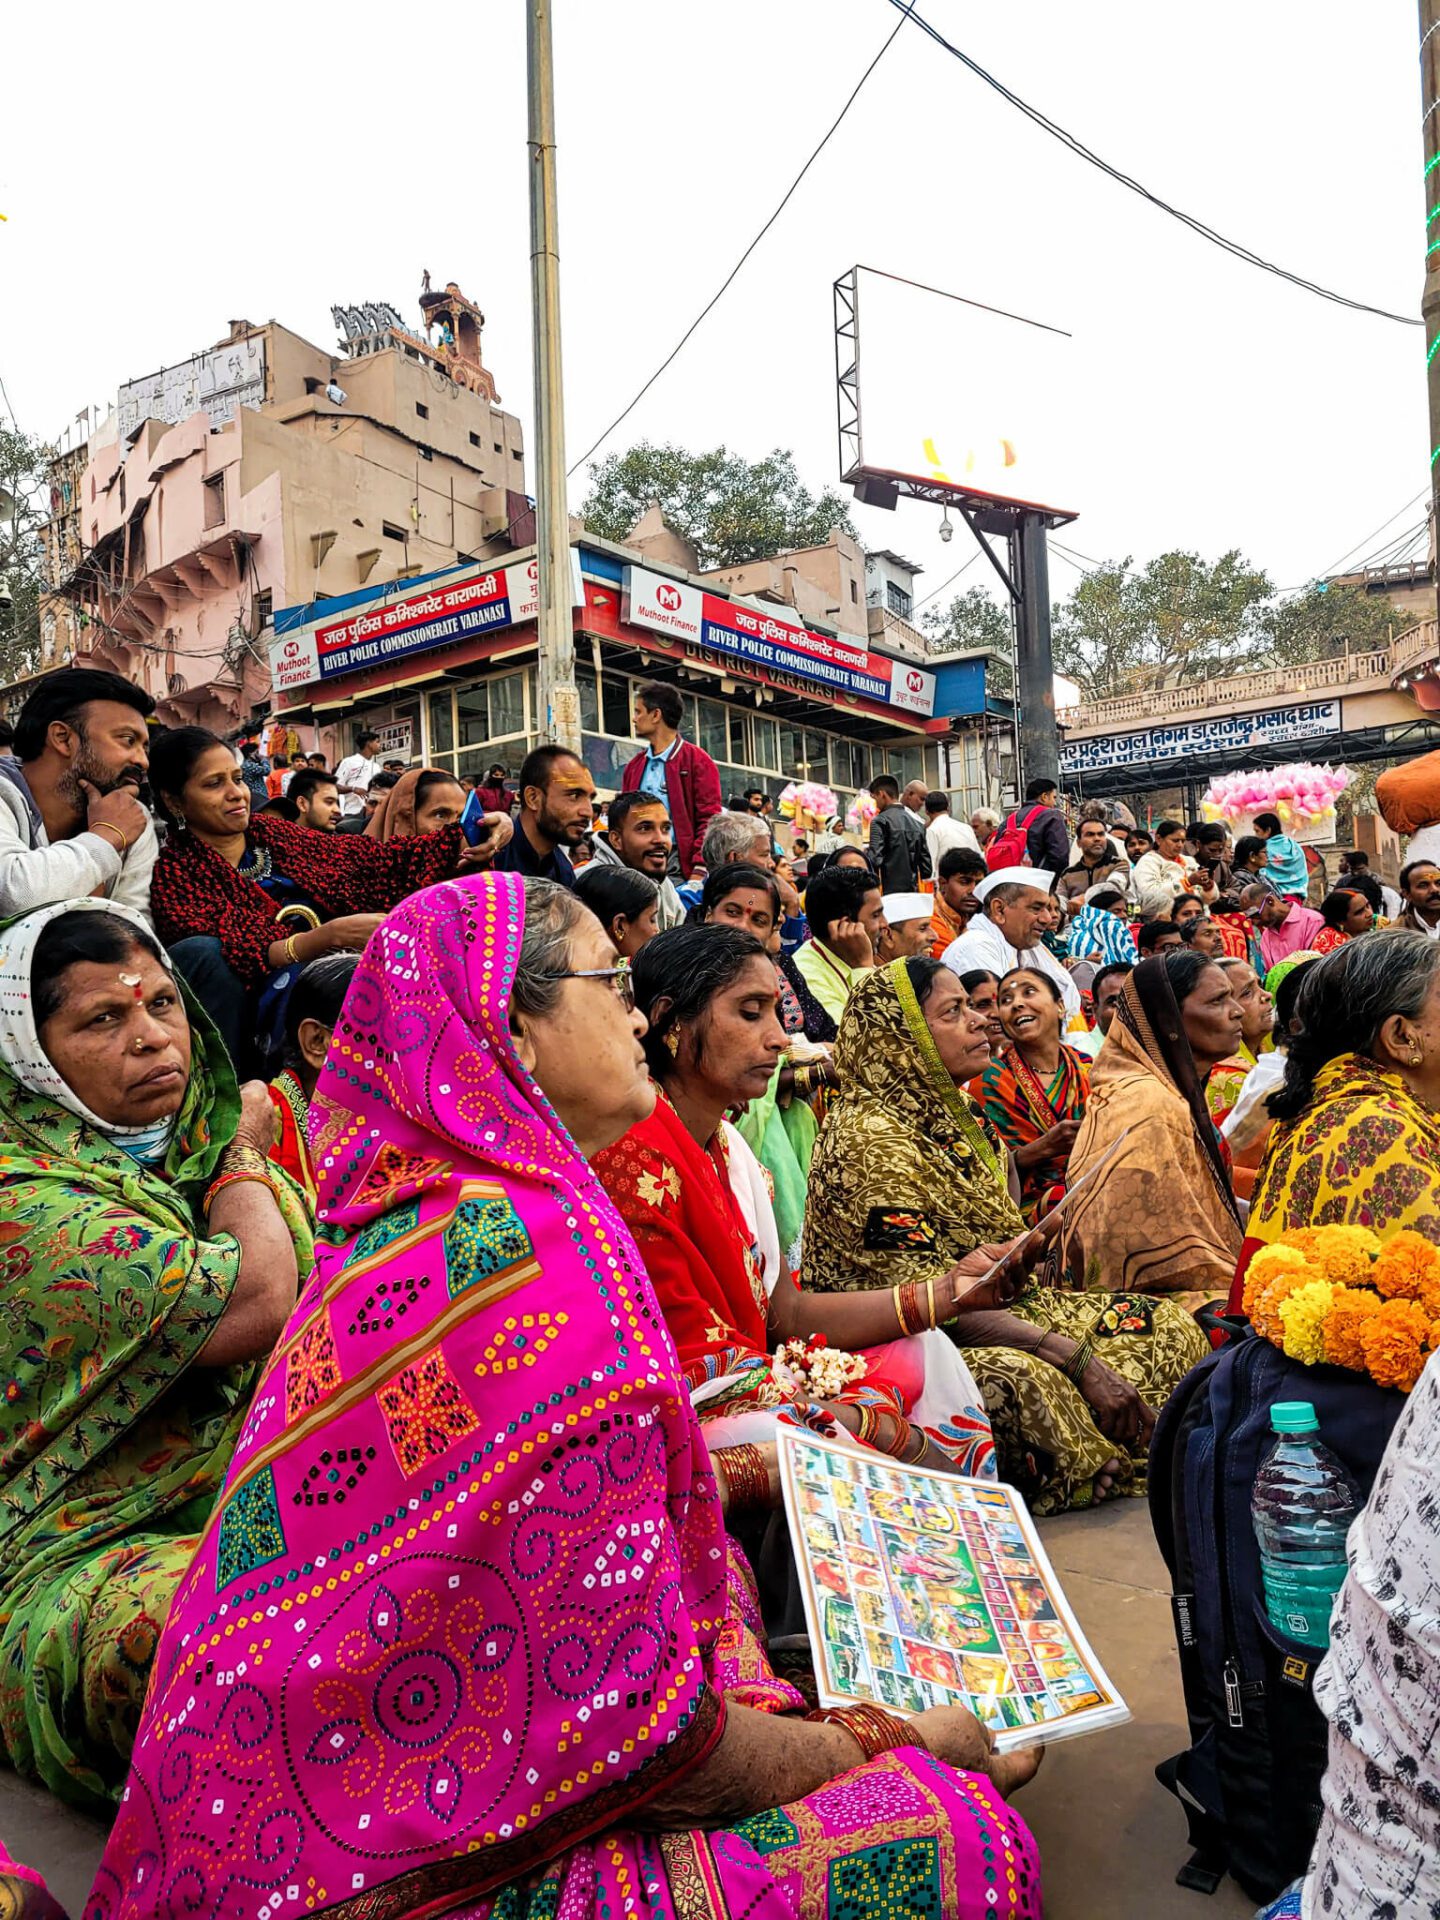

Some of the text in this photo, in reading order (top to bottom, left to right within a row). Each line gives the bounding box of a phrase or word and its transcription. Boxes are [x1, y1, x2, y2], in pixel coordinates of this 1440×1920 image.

[322, 627, 347, 644] जल
[348, 616, 382, 644] पुलिस
[383, 595, 443, 626] कमिश्नरेट
[444, 574, 497, 606] वाराणसी
[637, 605, 698, 633] Muthoot Finance
[323, 651, 349, 671] RIVER
[349, 641, 380, 664] POLICE
[380, 617, 459, 654] COMMISSIONERATE
[459, 603, 506, 630] VARANASI
[708, 625, 739, 650] RIVER
[740, 636, 774, 660] POLICE
[775, 649, 850, 685] COMMISSIONERATE
[850, 673, 886, 697] VARANASI
[735, 612, 868, 669] जल पुलिस कमिश्नरेट वाराणसी
[276, 655, 310, 673] Muthoot
[280, 669, 311, 686] Finance
[768, 667, 837, 700] VARANASI
[1078, 737, 1115, 757] प्रदेश
[1116, 734, 1147, 751] जल
[1149, 727, 1189, 747] निगम
[1255, 708, 1297, 730] प्रसाद
[1298, 703, 1334, 721] घाट
[1177, 1597, 1194, 1647] FB ORIGINALS
